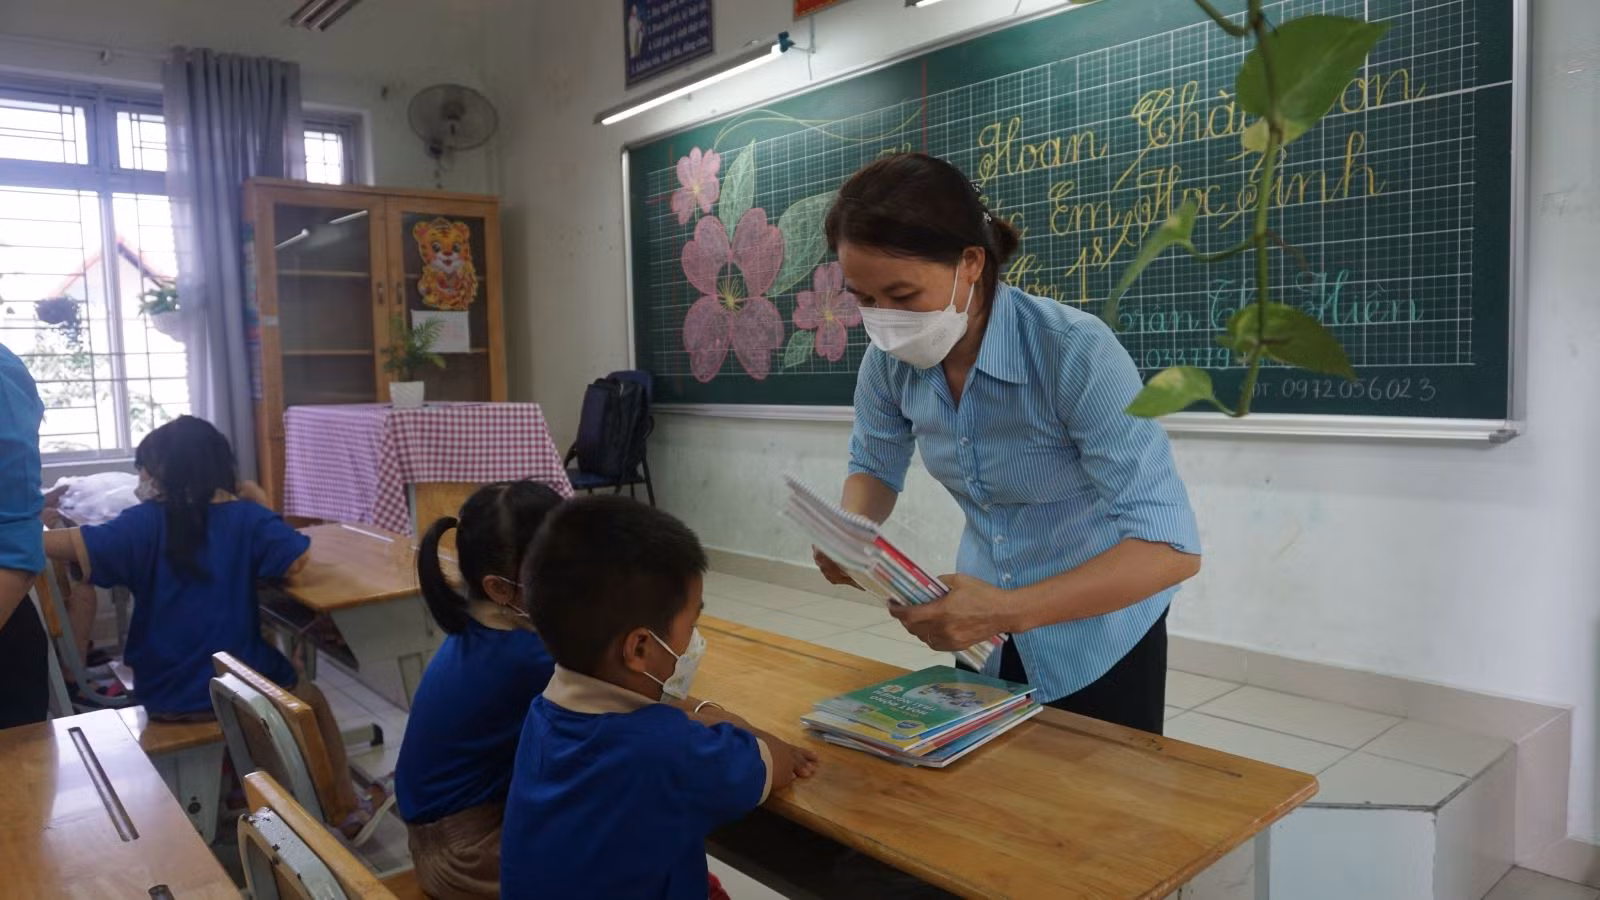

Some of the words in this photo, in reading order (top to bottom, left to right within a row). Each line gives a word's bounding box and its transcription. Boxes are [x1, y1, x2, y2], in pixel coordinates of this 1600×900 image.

[979, 117, 1107, 187] Hoan
[1118, 80, 1246, 173] Chà
[1048, 182, 1120, 236] Em
